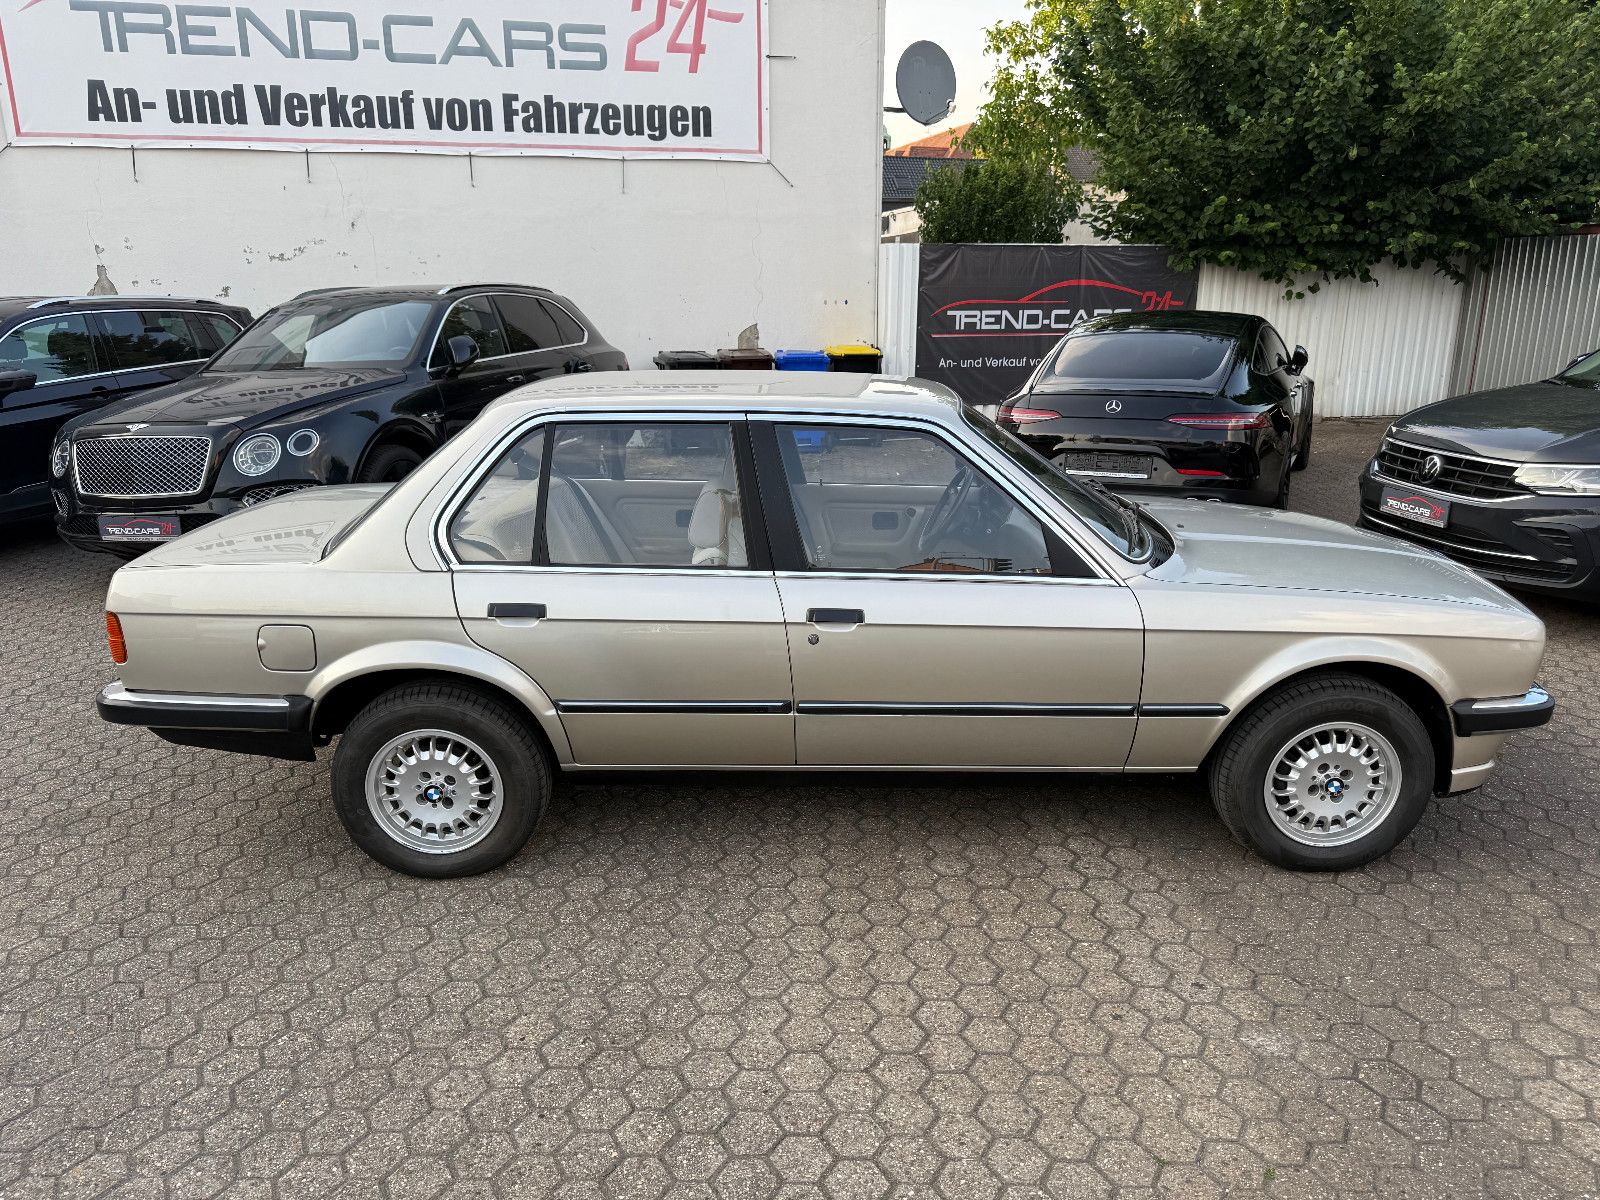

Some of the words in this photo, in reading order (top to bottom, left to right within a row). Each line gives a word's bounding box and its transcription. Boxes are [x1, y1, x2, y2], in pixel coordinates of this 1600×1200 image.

[69, 0, 608, 71] TREND-CARS
[87, 79, 157, 123] An-
[165, 83, 249, 125] und
[253, 84, 415, 130] Verkauf
[422, 97, 494, 132] von
[501, 93, 713, 142] Fahrzeugen
[946, 308, 1132, 330] TREND-CA
[938, 357, 958, 368] An-
[960, 357, 983, 368] und
[984, 356, 1027, 368] Verkauf
